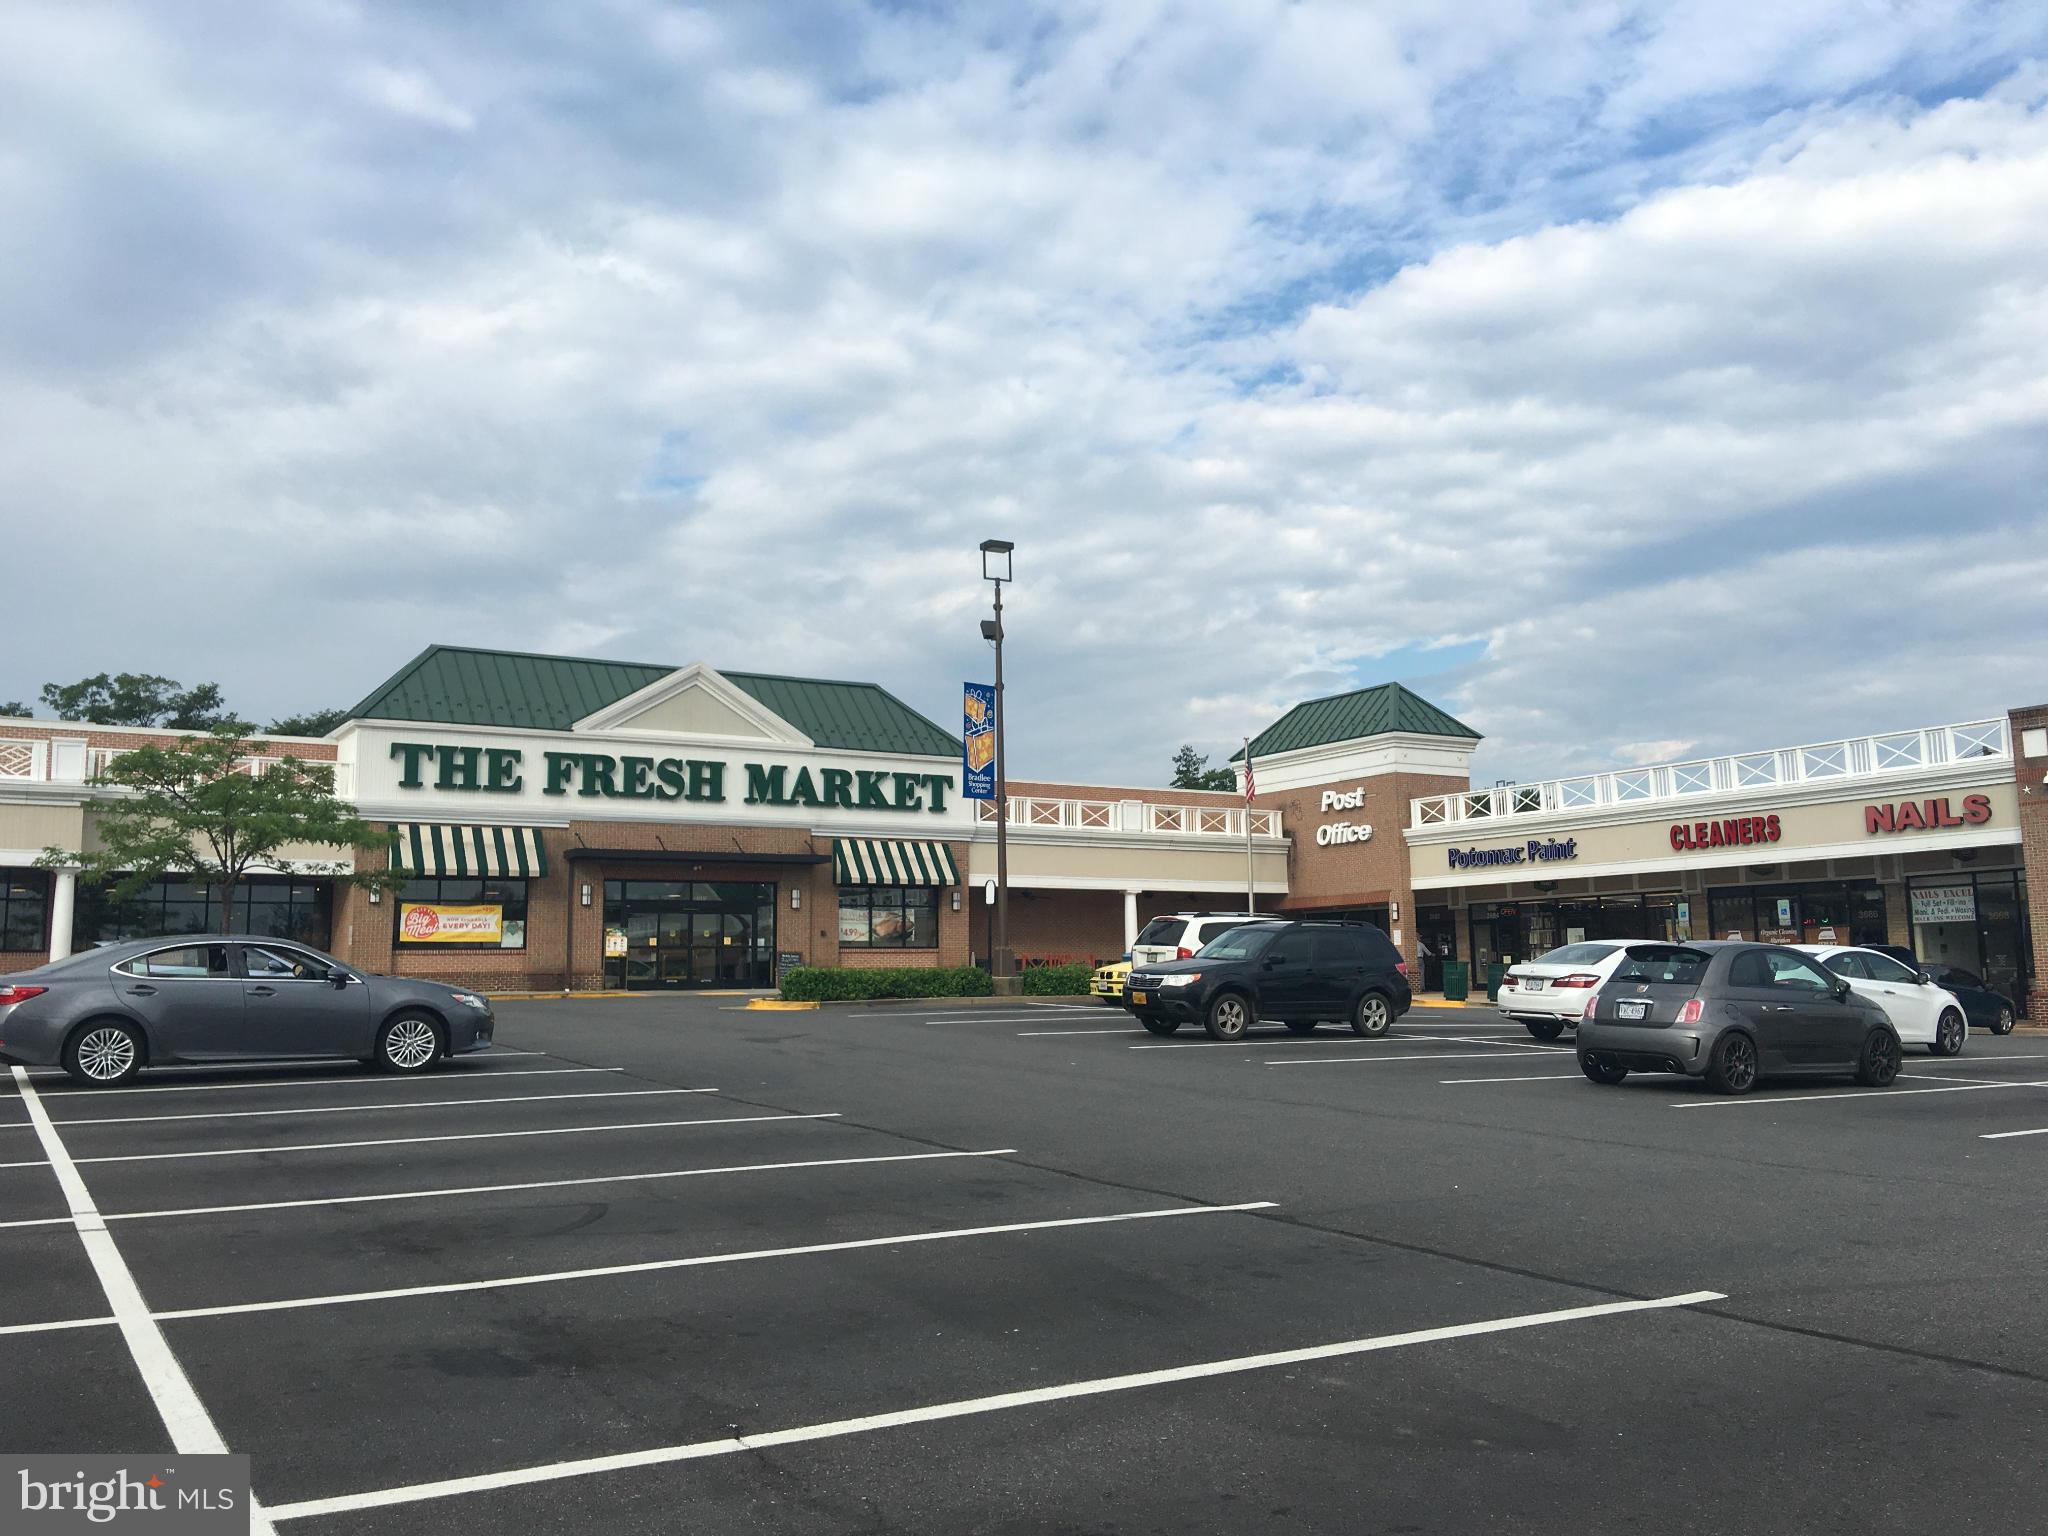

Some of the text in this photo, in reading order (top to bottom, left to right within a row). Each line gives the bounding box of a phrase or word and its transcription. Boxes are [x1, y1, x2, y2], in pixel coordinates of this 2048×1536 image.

[390, 742, 954, 812] THE FRESH MARKET
[968, 773, 991, 781] Bradlee
[968, 780, 991, 789] Shopping
[1321, 786, 1366, 812] Post
[1865, 794, 1993, 833] NAILS
[1316, 822, 1373, 846] Office
[1669, 815, 1781, 850] CLEANERS
[1448, 838, 1578, 868] Potomac Paint
[1912, 890, 1939, 899] NAILS
[407, 912, 432, 927] Big
[443, 922, 491, 930] EVERY DAY!
[405, 923, 439, 938] Meal
[1760, 928, 1778, 936] Organic
